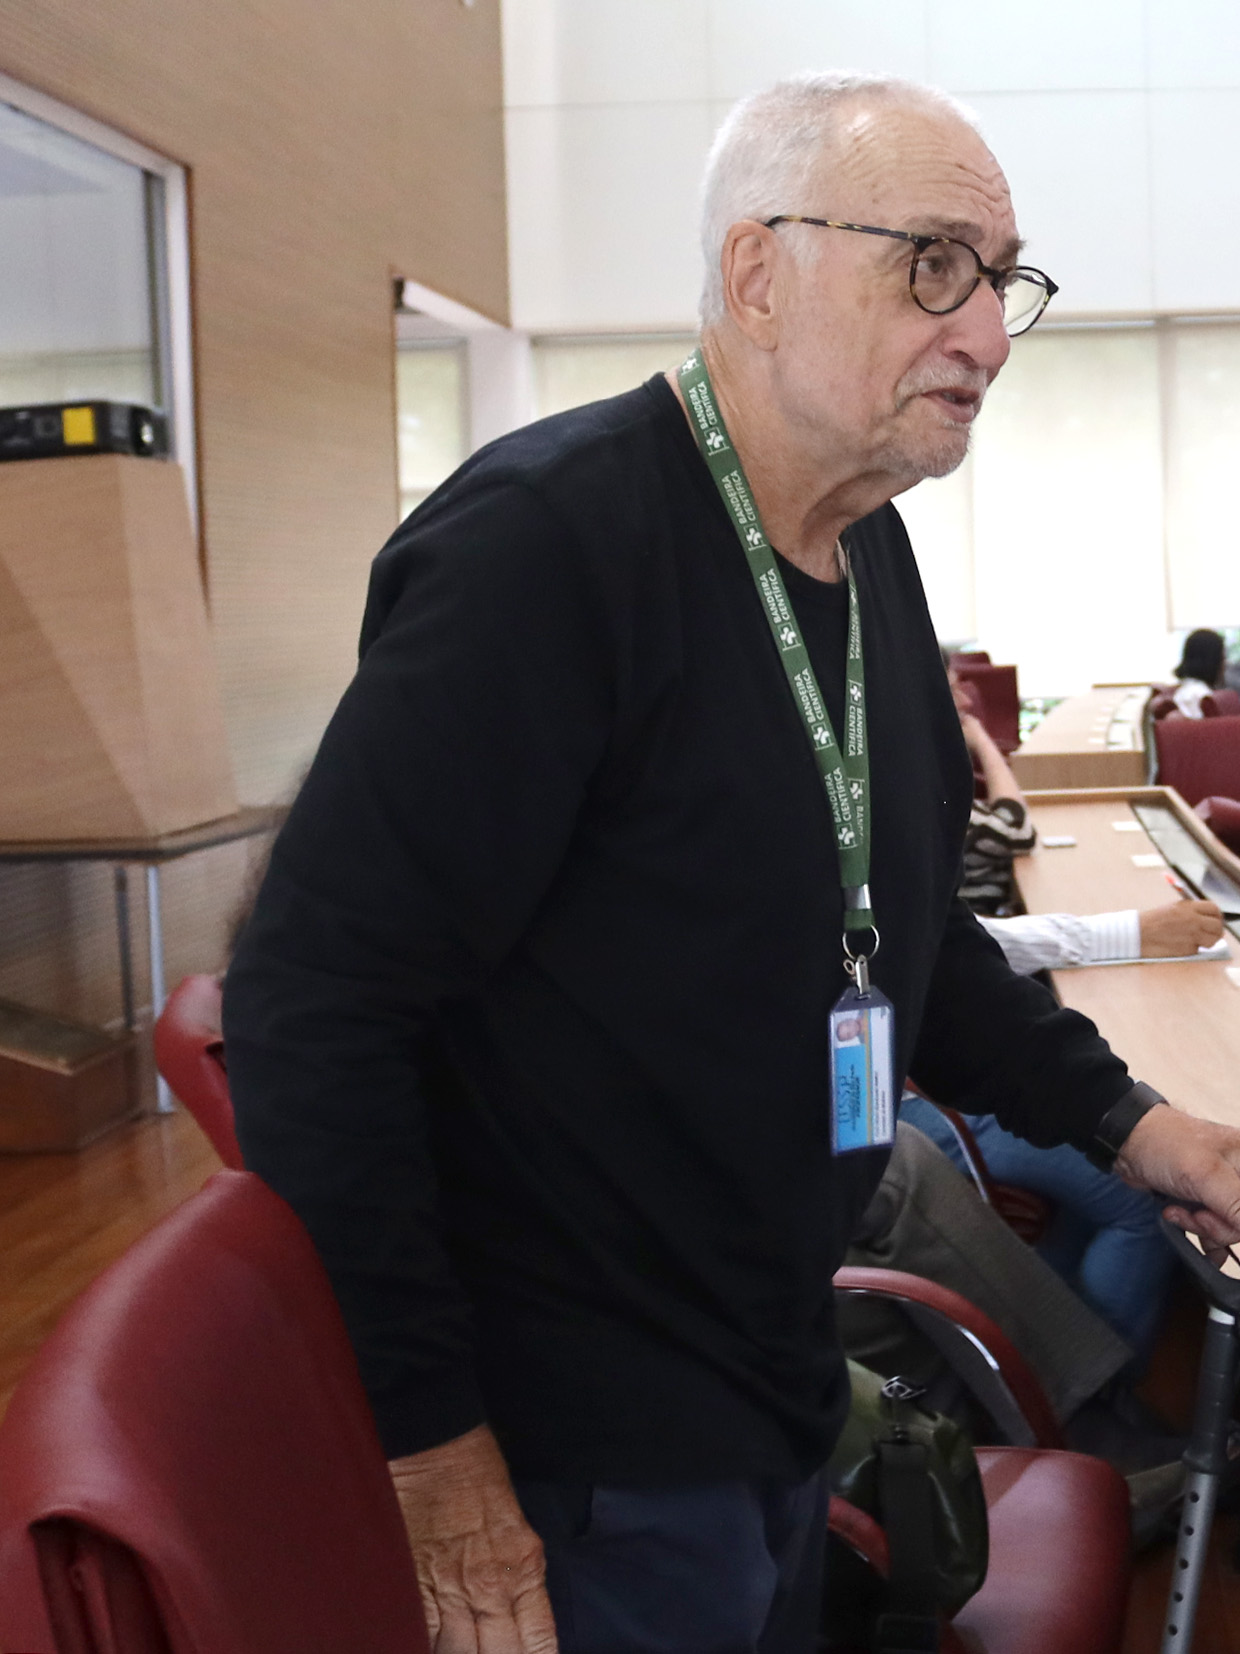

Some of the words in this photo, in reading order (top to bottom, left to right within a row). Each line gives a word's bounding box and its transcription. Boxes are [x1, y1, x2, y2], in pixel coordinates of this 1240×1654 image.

[688, 386, 707, 430] BANDEIRA
[721, 474, 748, 524] BANDEIRA
[759, 573, 782, 624] BANDEIRA
[793, 673, 816, 724] BANDEIRA
[856, 707, 864, 756] BANDEIRA
[825, 772, 842, 823] BANDEIRA
